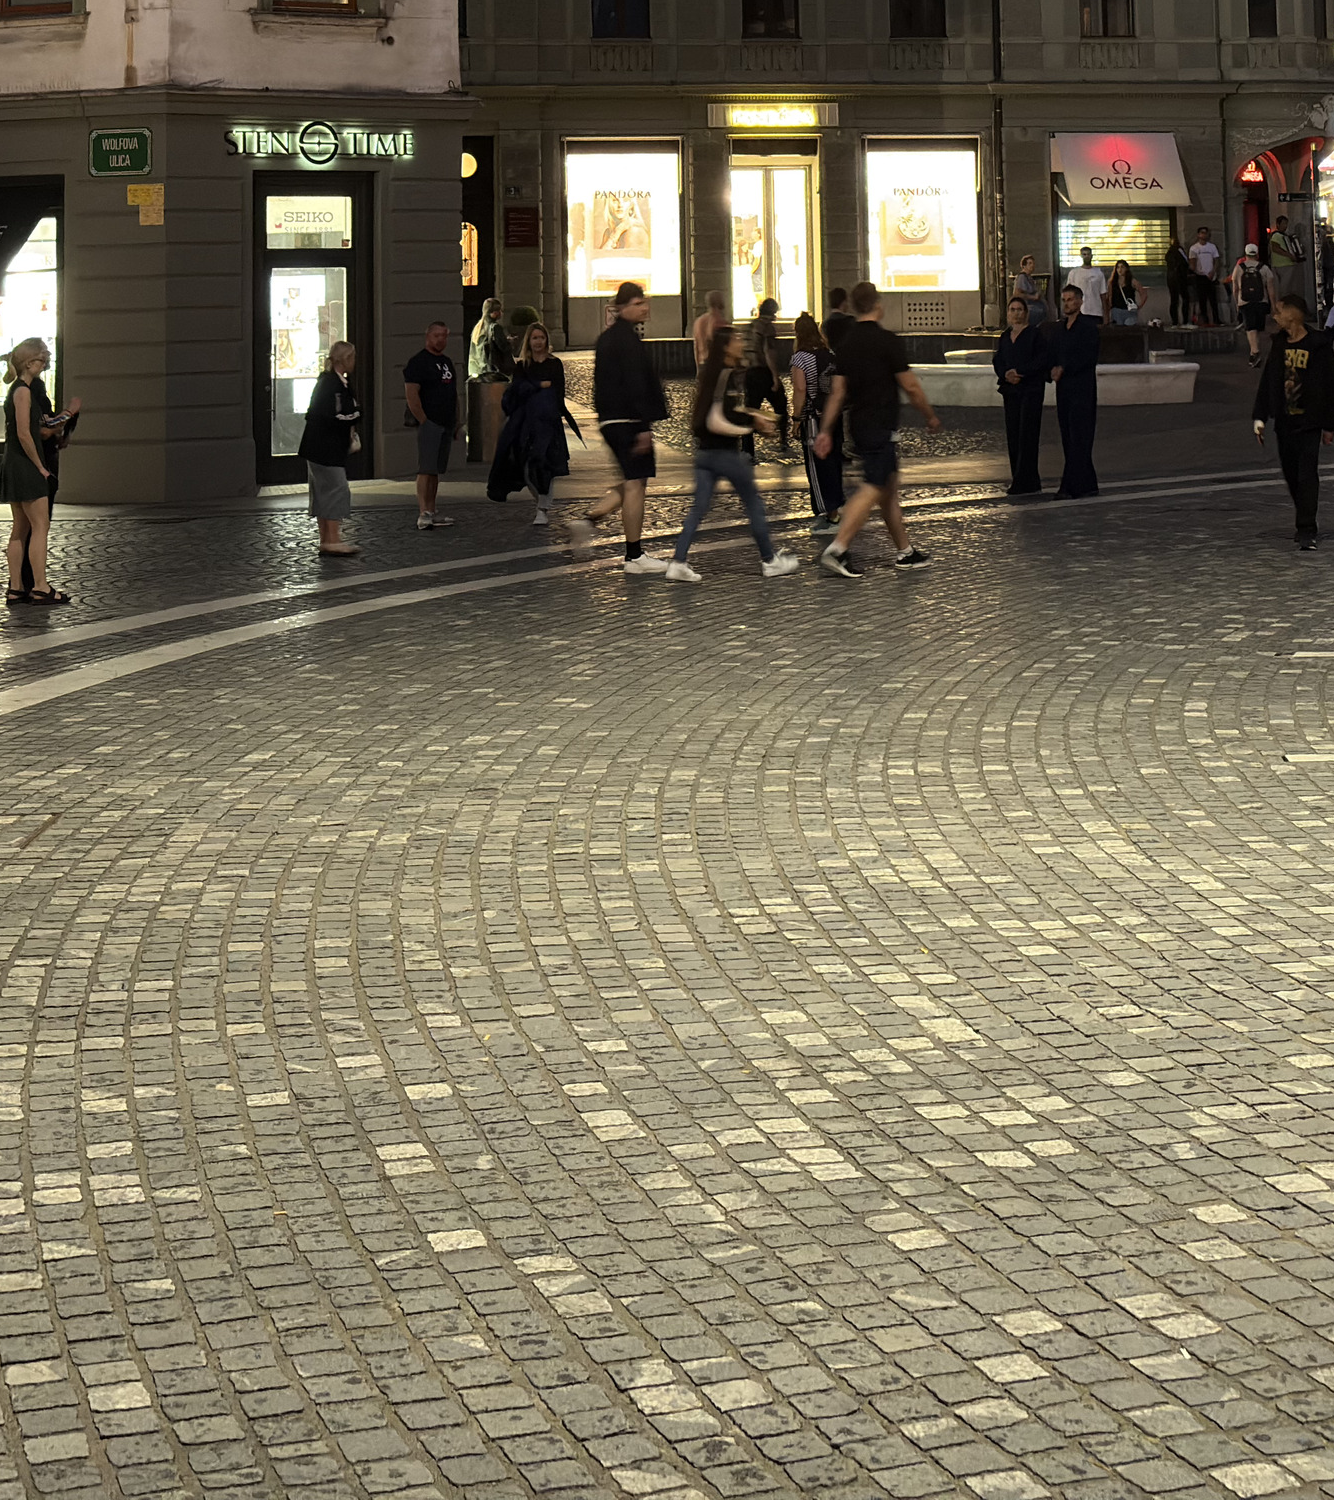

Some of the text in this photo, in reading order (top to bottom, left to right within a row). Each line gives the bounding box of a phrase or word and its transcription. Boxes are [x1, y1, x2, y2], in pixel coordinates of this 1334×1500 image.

[102, 137, 138, 151] WOLFOVA
[224, 130, 414, 156] STEN TIME
[109, 154, 131, 167] ULICA
[1090, 177, 1163, 190] OMEGA
[284, 212, 334, 223] SEIKO
